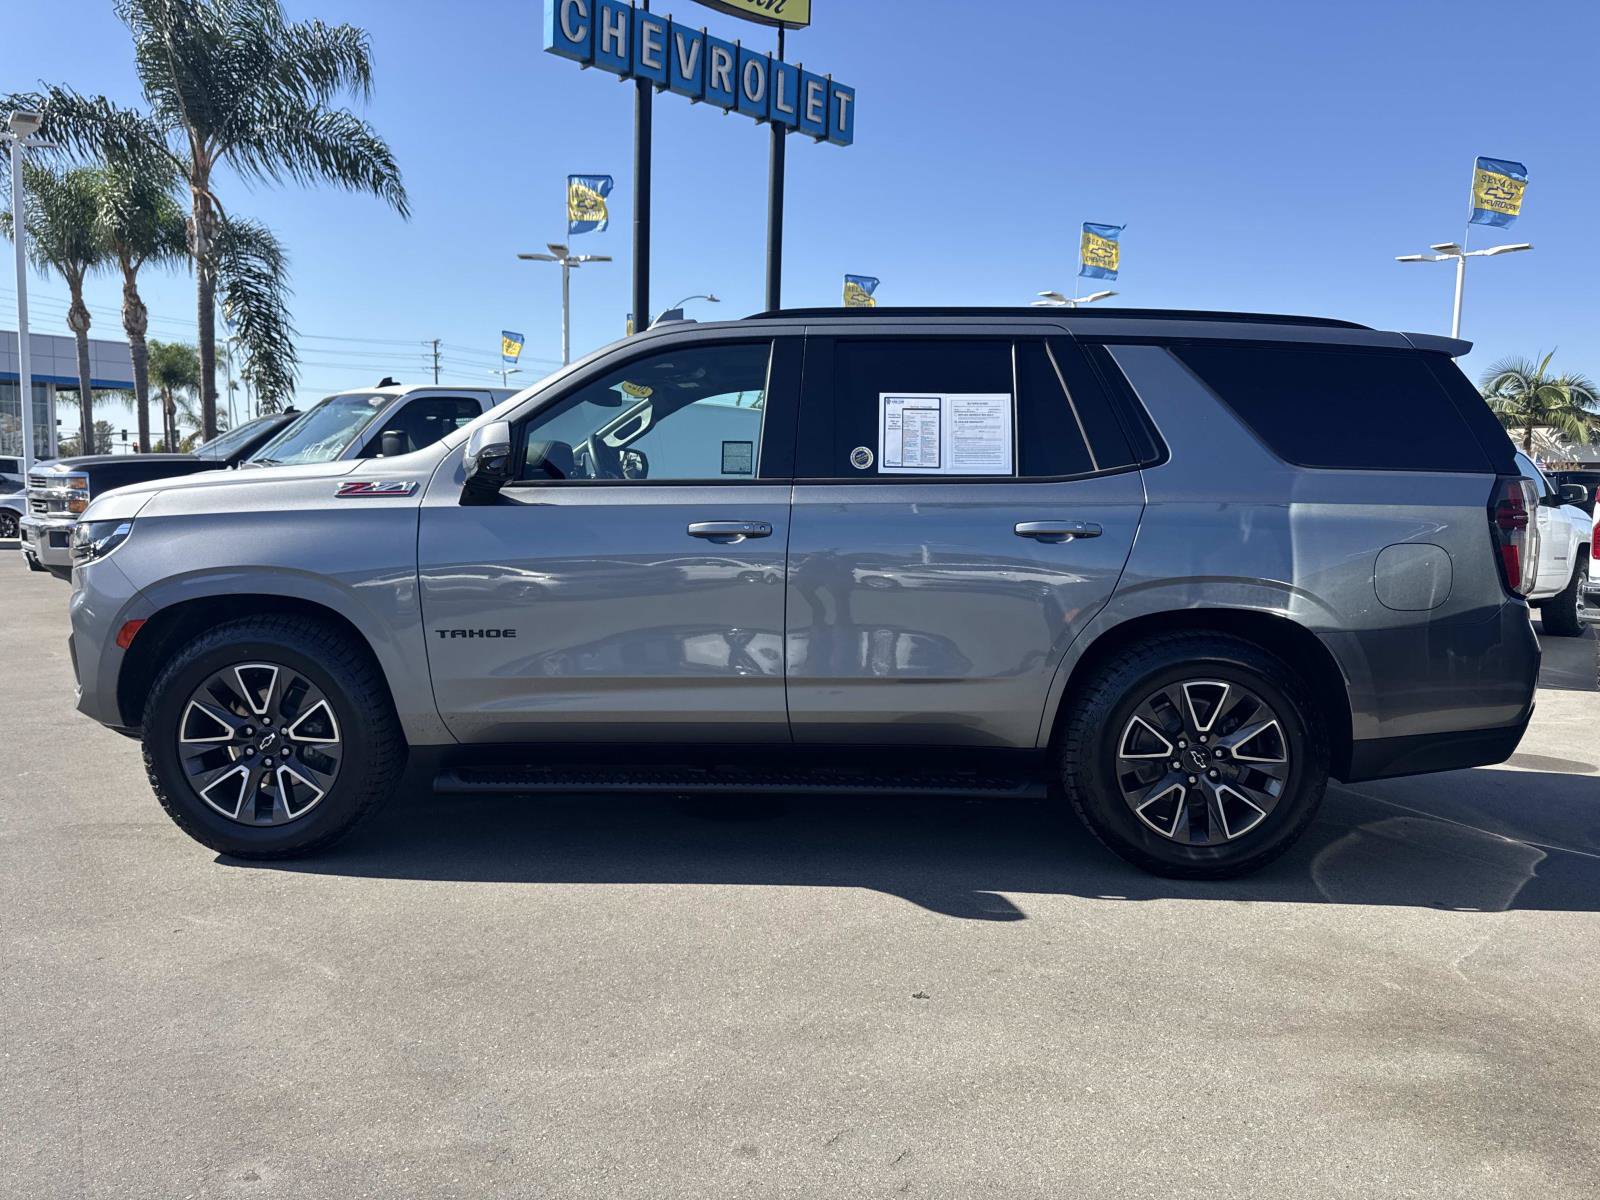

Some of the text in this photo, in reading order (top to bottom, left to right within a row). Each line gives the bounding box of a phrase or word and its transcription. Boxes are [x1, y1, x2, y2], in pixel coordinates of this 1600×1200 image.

[560, 0, 854, 132] CHEVROLET
[335, 481, 421, 498] Z71
[435, 629, 517, 638] TAHOE
